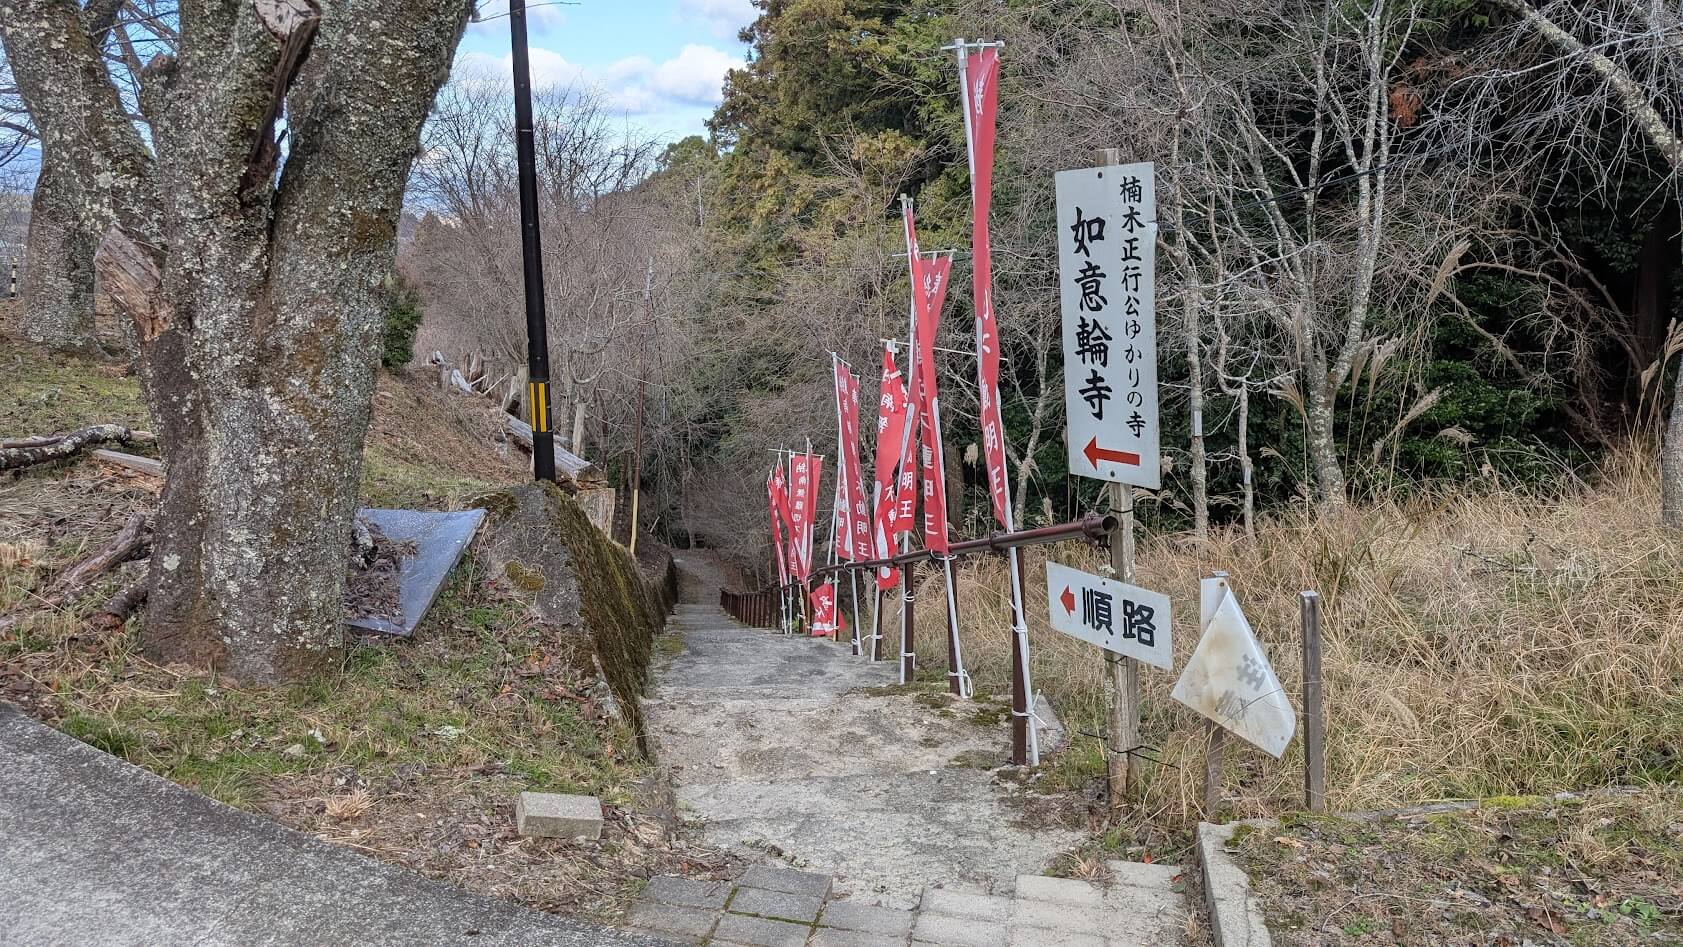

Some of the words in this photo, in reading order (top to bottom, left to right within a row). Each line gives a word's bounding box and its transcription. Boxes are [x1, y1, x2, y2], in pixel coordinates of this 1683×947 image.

[1070, 206, 1113, 421] 如意輪寺
[1120, 176, 1147, 439] 楠木正行公ゆかりの寺
[1082, 586, 1157, 648] 順路
